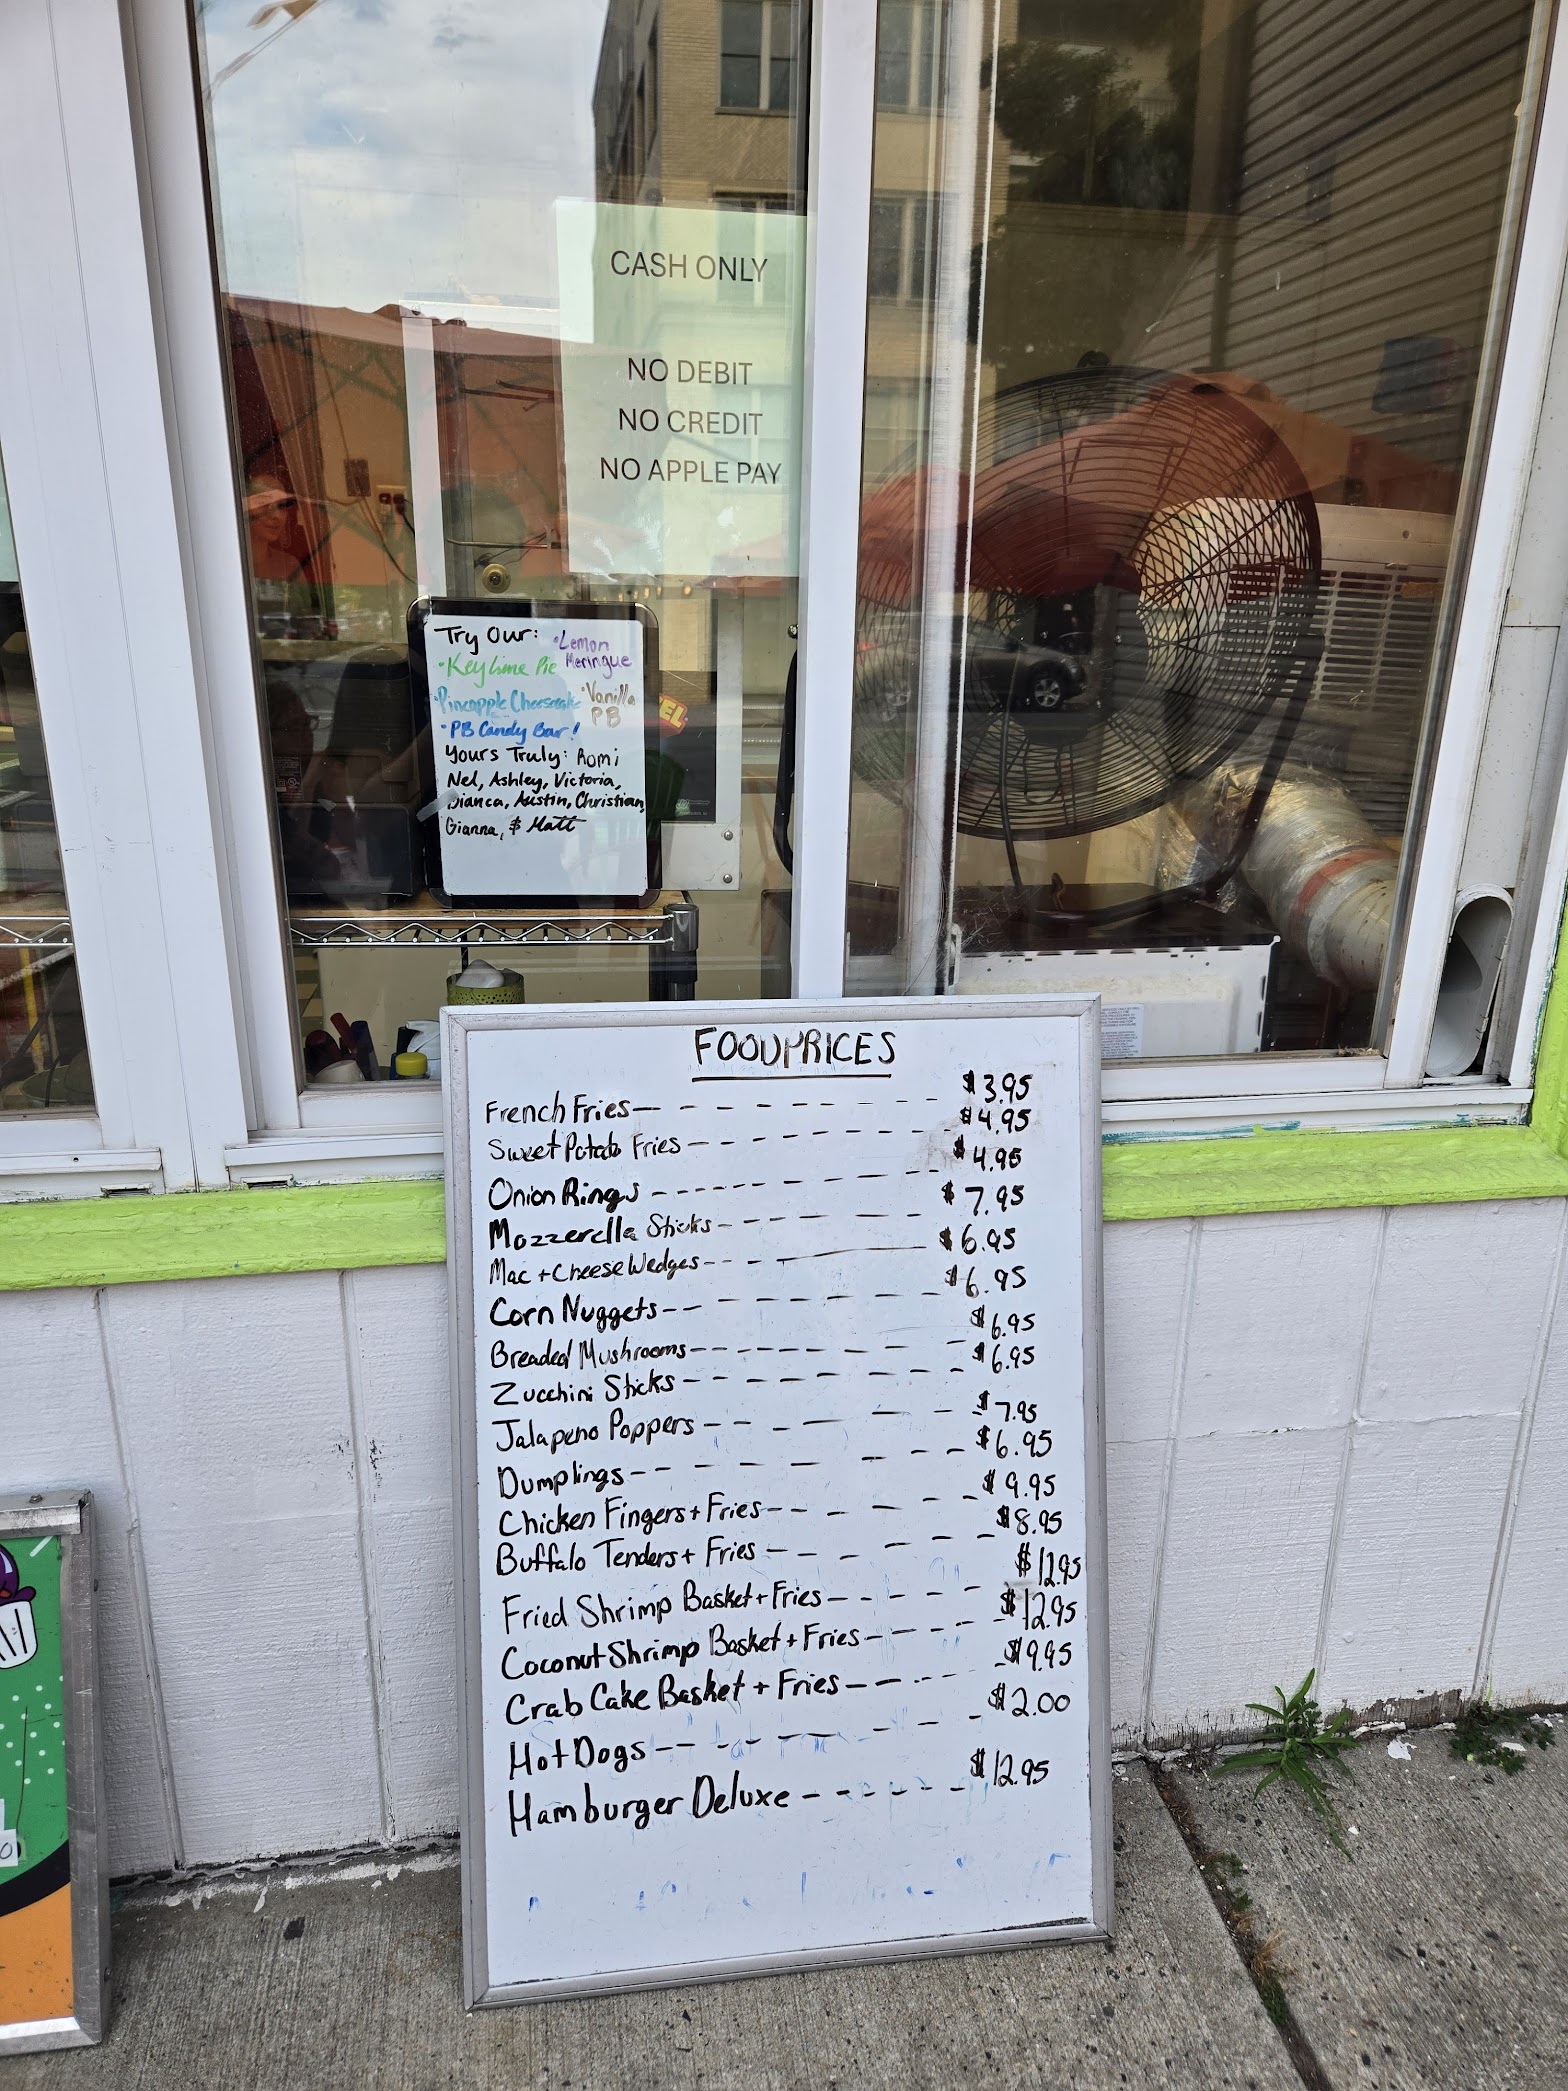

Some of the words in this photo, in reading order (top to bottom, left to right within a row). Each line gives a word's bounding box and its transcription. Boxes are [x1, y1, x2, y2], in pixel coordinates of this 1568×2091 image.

[610, 250, 688, 278] CASH
[696, 254, 768, 282] ONLY
[628, 358, 668, 382] NO
[677, 360, 752, 385] DEBIT
[618, 408, 659, 432] NO
[667, 410, 763, 436] CREDIT
[600, 457, 640, 481] NO
[648, 459, 729, 484] APPLE
[736, 462, 782, 485] PAY
[434, 626, 478, 655] Try
[487, 626, 538, 644] Our:
[535, 655, 557, 676] Pie
[566, 652, 632, 679] Meringue
[586, 680, 636, 706] Vanilla
[450, 722, 474, 739] PB
[478, 720, 527, 744] Candy
[591, 706, 621, 728] PB
[445, 744, 498, 765] Yours
[489, 770, 548, 794] Ashley,
[554, 772, 622, 790] Victoria,
[514, 790, 571, 810] Austin,
[446, 816, 503, 840] Gianna,
[526, 815, 587, 834] Matt
[486, 1090, 564, 1124] French
[574, 1094, 631, 1122] Fries
[962, 1070, 1033, 1104] $3.95
[488, 1129, 561, 1162] Sweet
[564, 1131, 622, 1162] Potato
[632, 1133, 681, 1160] Fries
[960, 1106, 1032, 1135] $4.95
[488, 1177, 555, 1210] Onion
[562, 1176, 640, 1214] Rings
[646, 1213, 712, 1238] Sticks
[941, 1180, 1024, 1216] $7.95
[489, 1258, 532, 1286] Mac
[628, 1248, 700, 1280] Wedges
[939, 1224, 1016, 1254] $6.95
[490, 1297, 554, 1326] Corn
[562, 1293, 658, 1333] Nuggets
[945, 1264, 1026, 1298] $6.95
[490, 1339, 572, 1370] Breaded
[579, 1336, 686, 1370] Mushrooms
[970, 1304, 1036, 1340] $6.95
[490, 1381, 593, 1406] Zucchini
[604, 1369, 676, 1402] Sticks
[972, 1342, 1036, 1374] $6.95
[492, 1418, 599, 1454] Jalapeno
[610, 1408, 694, 1445] Poppers
[976, 1390, 1038, 1422] $7.95
[498, 1460, 624, 1500] Dumplings
[976, 1425, 1052, 1459] $6.95
[500, 1503, 595, 1536] Chicken
[706, 1492, 762, 1522] Fries
[982, 1469, 1056, 1500] $9.95
[496, 1542, 586, 1576] Buffalo
[706, 1536, 756, 1568] Fries
[996, 1505, 1063, 1536] $8.95
[501, 1642, 606, 1680] Coconut
[608, 1638, 700, 1668] Shrimp
[1000, 1588, 1078, 1630] $12.95
[502, 1594, 568, 1634] Fried
[577, 1592, 672, 1628] Shrimp
[506, 1688, 583, 1726] Crab
[590, 1680, 650, 1712] Cake
[658, 1668, 745, 1710] Basket
[778, 1668, 840, 1700] Fries
[509, 1738, 569, 1780] Hot
[574, 1736, 646, 1773] Dogs
[988, 1682, 1070, 1717] $2.00
[508, 1782, 684, 1837] Hamburger
[692, 1770, 790, 1819] Deluxe
[970, 1748, 1050, 1788] $12.95
